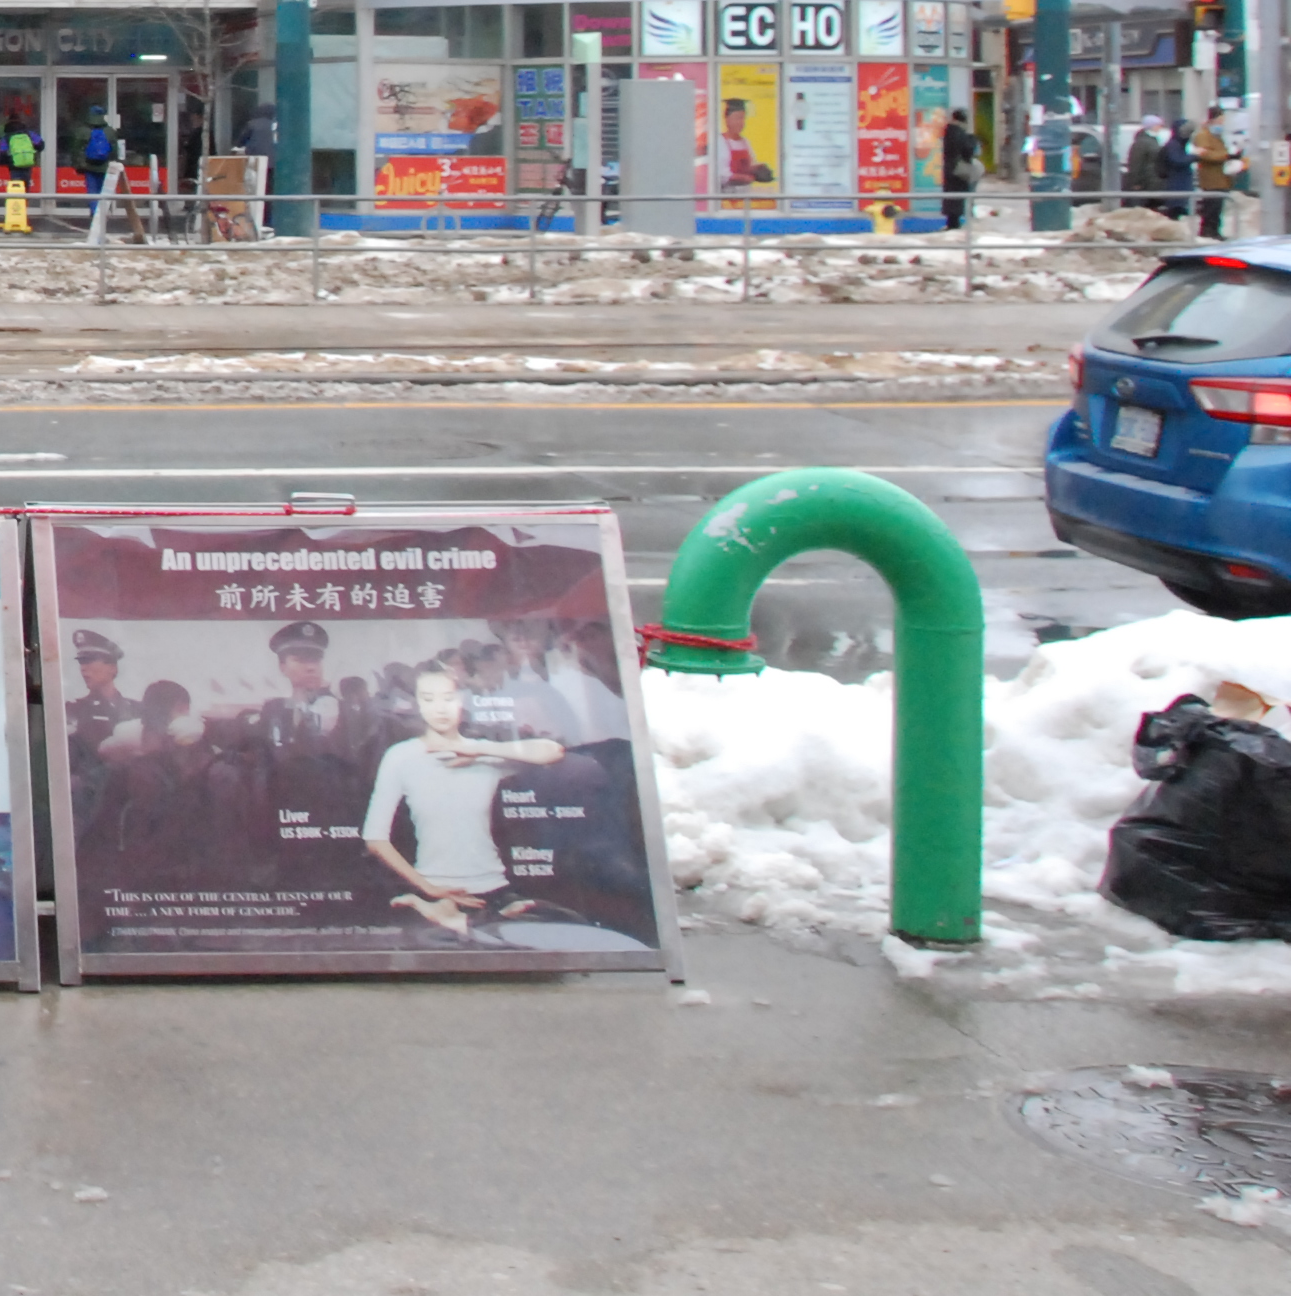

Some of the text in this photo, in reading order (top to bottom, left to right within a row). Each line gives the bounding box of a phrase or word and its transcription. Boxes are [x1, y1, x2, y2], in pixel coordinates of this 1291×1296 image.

[721, 4, 843, 48] ECHO
[58, 28, 116, 52] CITY
[161, 548, 498, 573] An unprecedented evil crime
[214, 580, 446, 612] 前所未有的迫害
[501, 789, 536, 803] Heart
[279, 809, 310, 823] Liver
[503, 807, 517, 819] US
[280, 827, 295, 840] US
[511, 846, 554, 863] Kidney
[513, 864, 528, 876] US
[142, 892, 154, 902] IS
[155, 892, 179, 903] ONE
[180, 891, 197, 903] OF
[198, 891, 220, 902] THE
[222, 891, 272, 902] CENTRAL
[276, 891, 309, 902] TESTS
[310, 891, 326, 901] OF
[328, 891, 354, 901] OUR
[105, 907, 132, 917] TIME
[160, 907, 185, 917] NEW
[188, 907, 220, 917] FORM
[221, 907, 237, 917] OF
